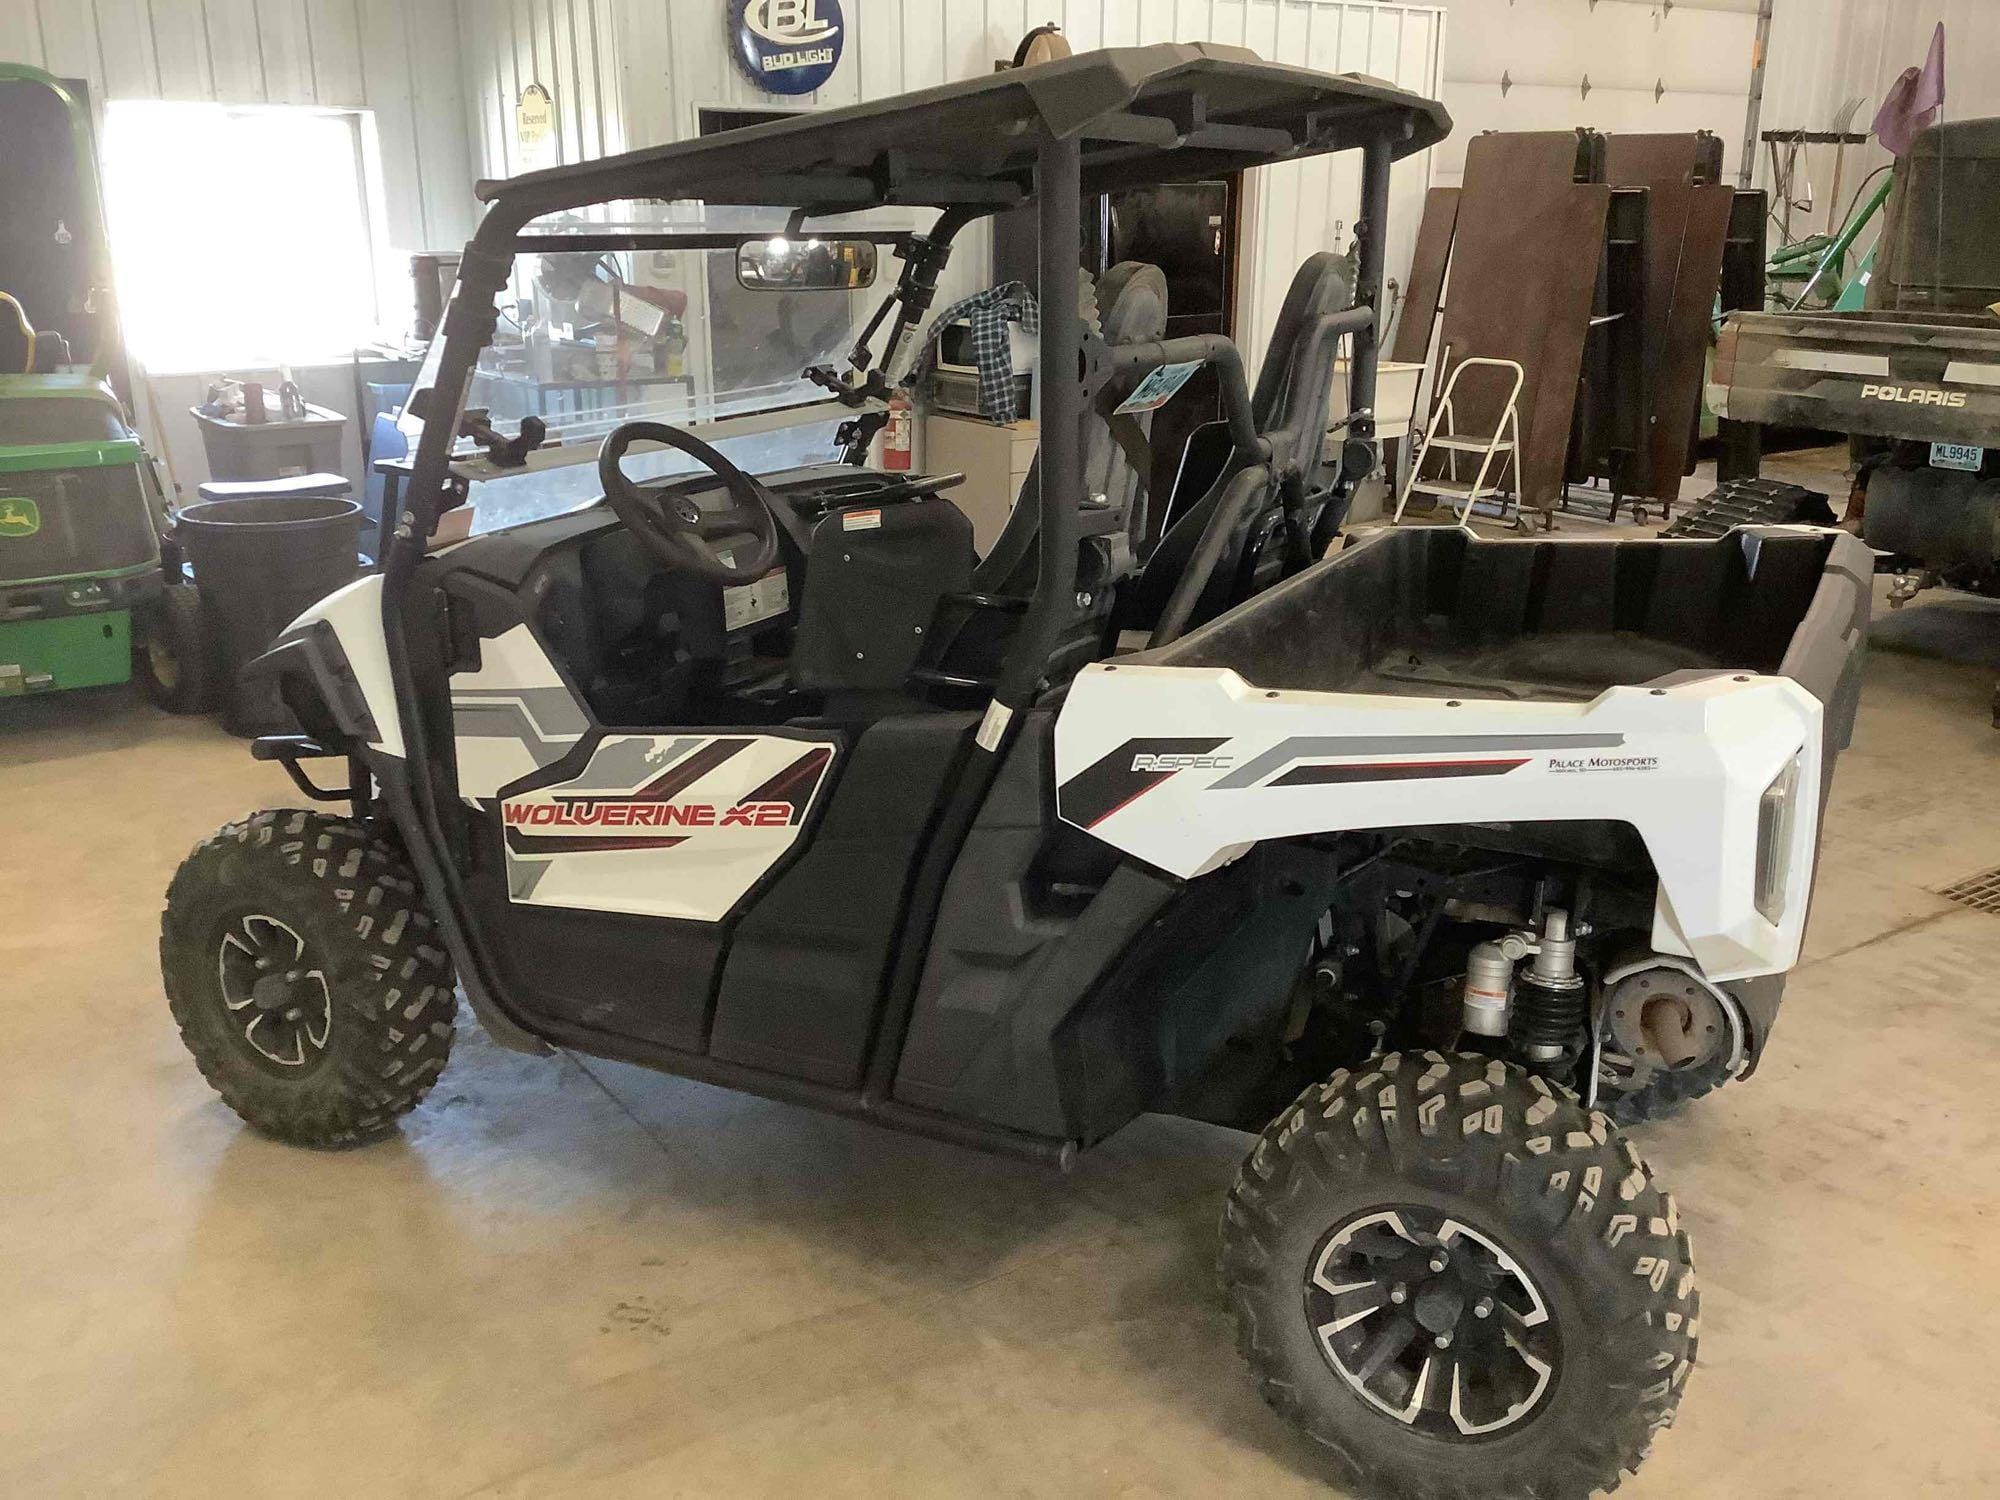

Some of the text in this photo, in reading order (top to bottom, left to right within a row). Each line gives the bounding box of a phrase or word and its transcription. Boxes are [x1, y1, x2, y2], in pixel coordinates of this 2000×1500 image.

[762, 48, 834, 71] BUD LIGHT
[1861, 384, 1967, 407] POLARIS
[1935, 445, 1978, 461] ML9945
[1549, 759, 1585, 768] PALACE
[1588, 757, 1659, 768] MOTOSPORTS
[504, 802, 791, 827] WOLVERINE X2
